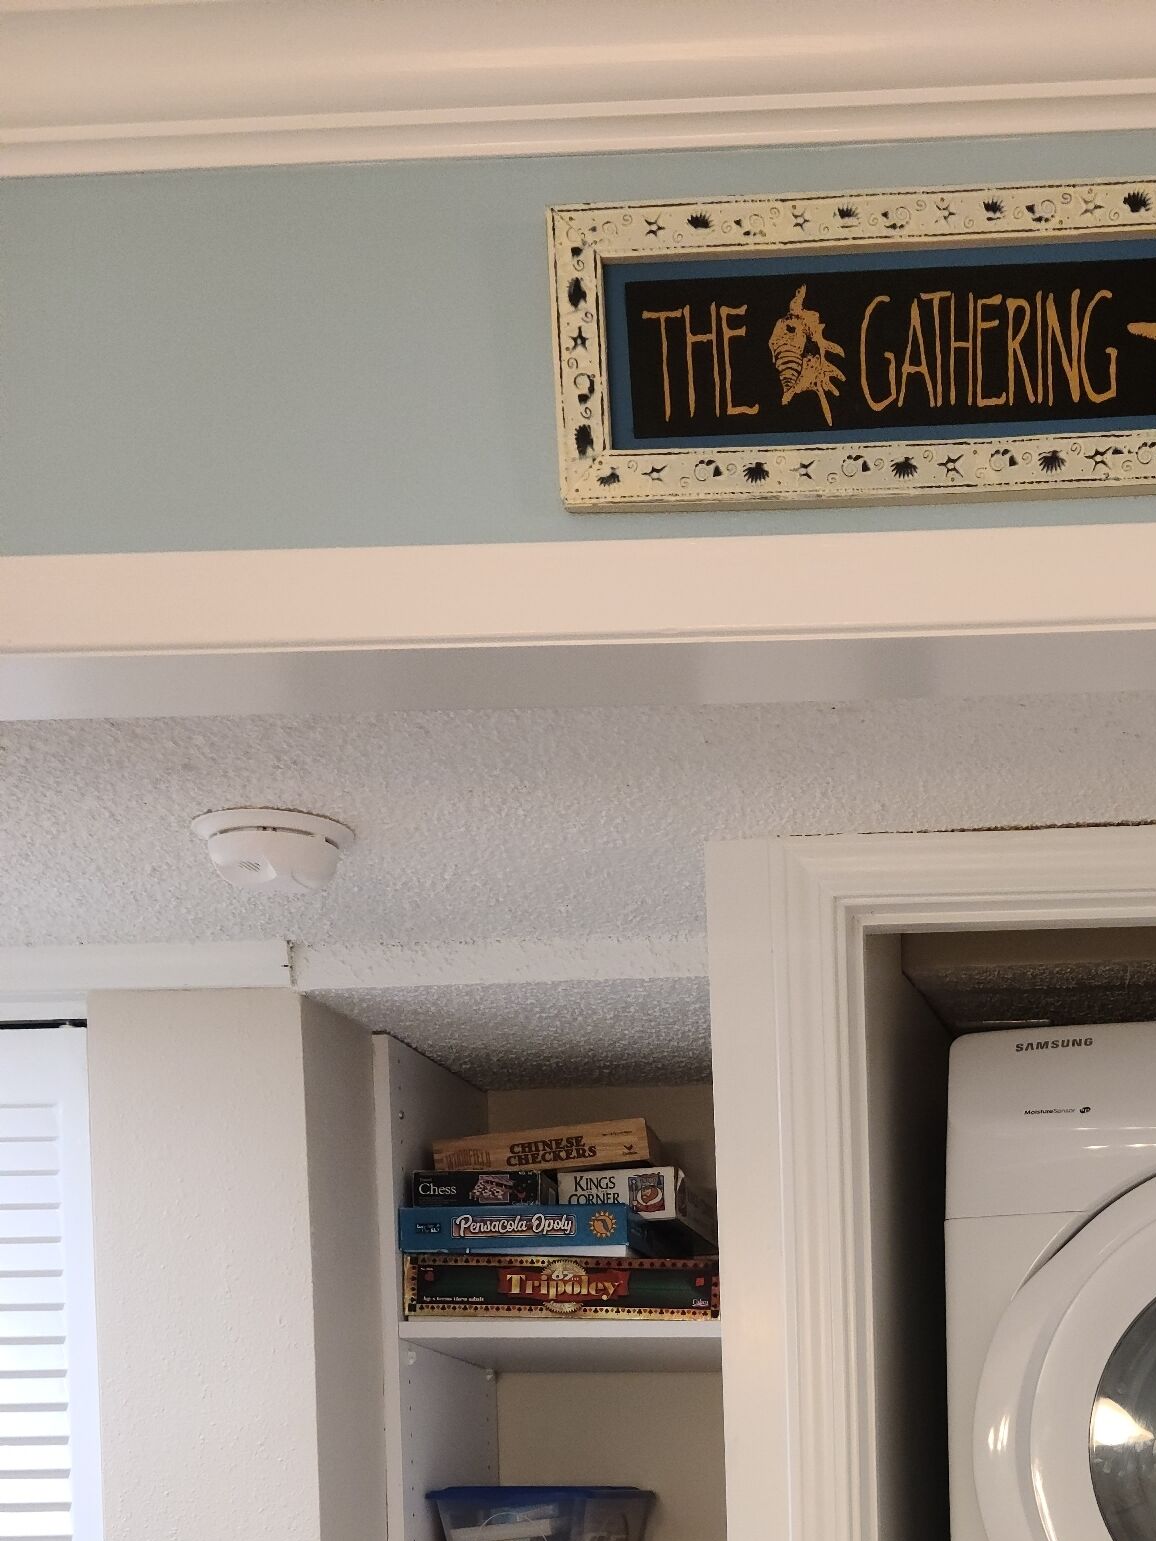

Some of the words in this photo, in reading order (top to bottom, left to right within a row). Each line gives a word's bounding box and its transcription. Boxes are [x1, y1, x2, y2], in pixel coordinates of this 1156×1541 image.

[642, 304, 760, 421] THE
[859, 290, 1119, 411] GATHERING
[1015, 1037, 1094, 1052] SAMSUNG
[509, 1136, 586, 1155] CHINESE
[506, 1145, 597, 1167] CHECKERS
[418, 1183, 457, 1195] Chess
[574, 1176, 616, 1192] KINGS
[568, 1192, 620, 1205] CORNER
[506, 1274, 620, 1301] Tripoley
